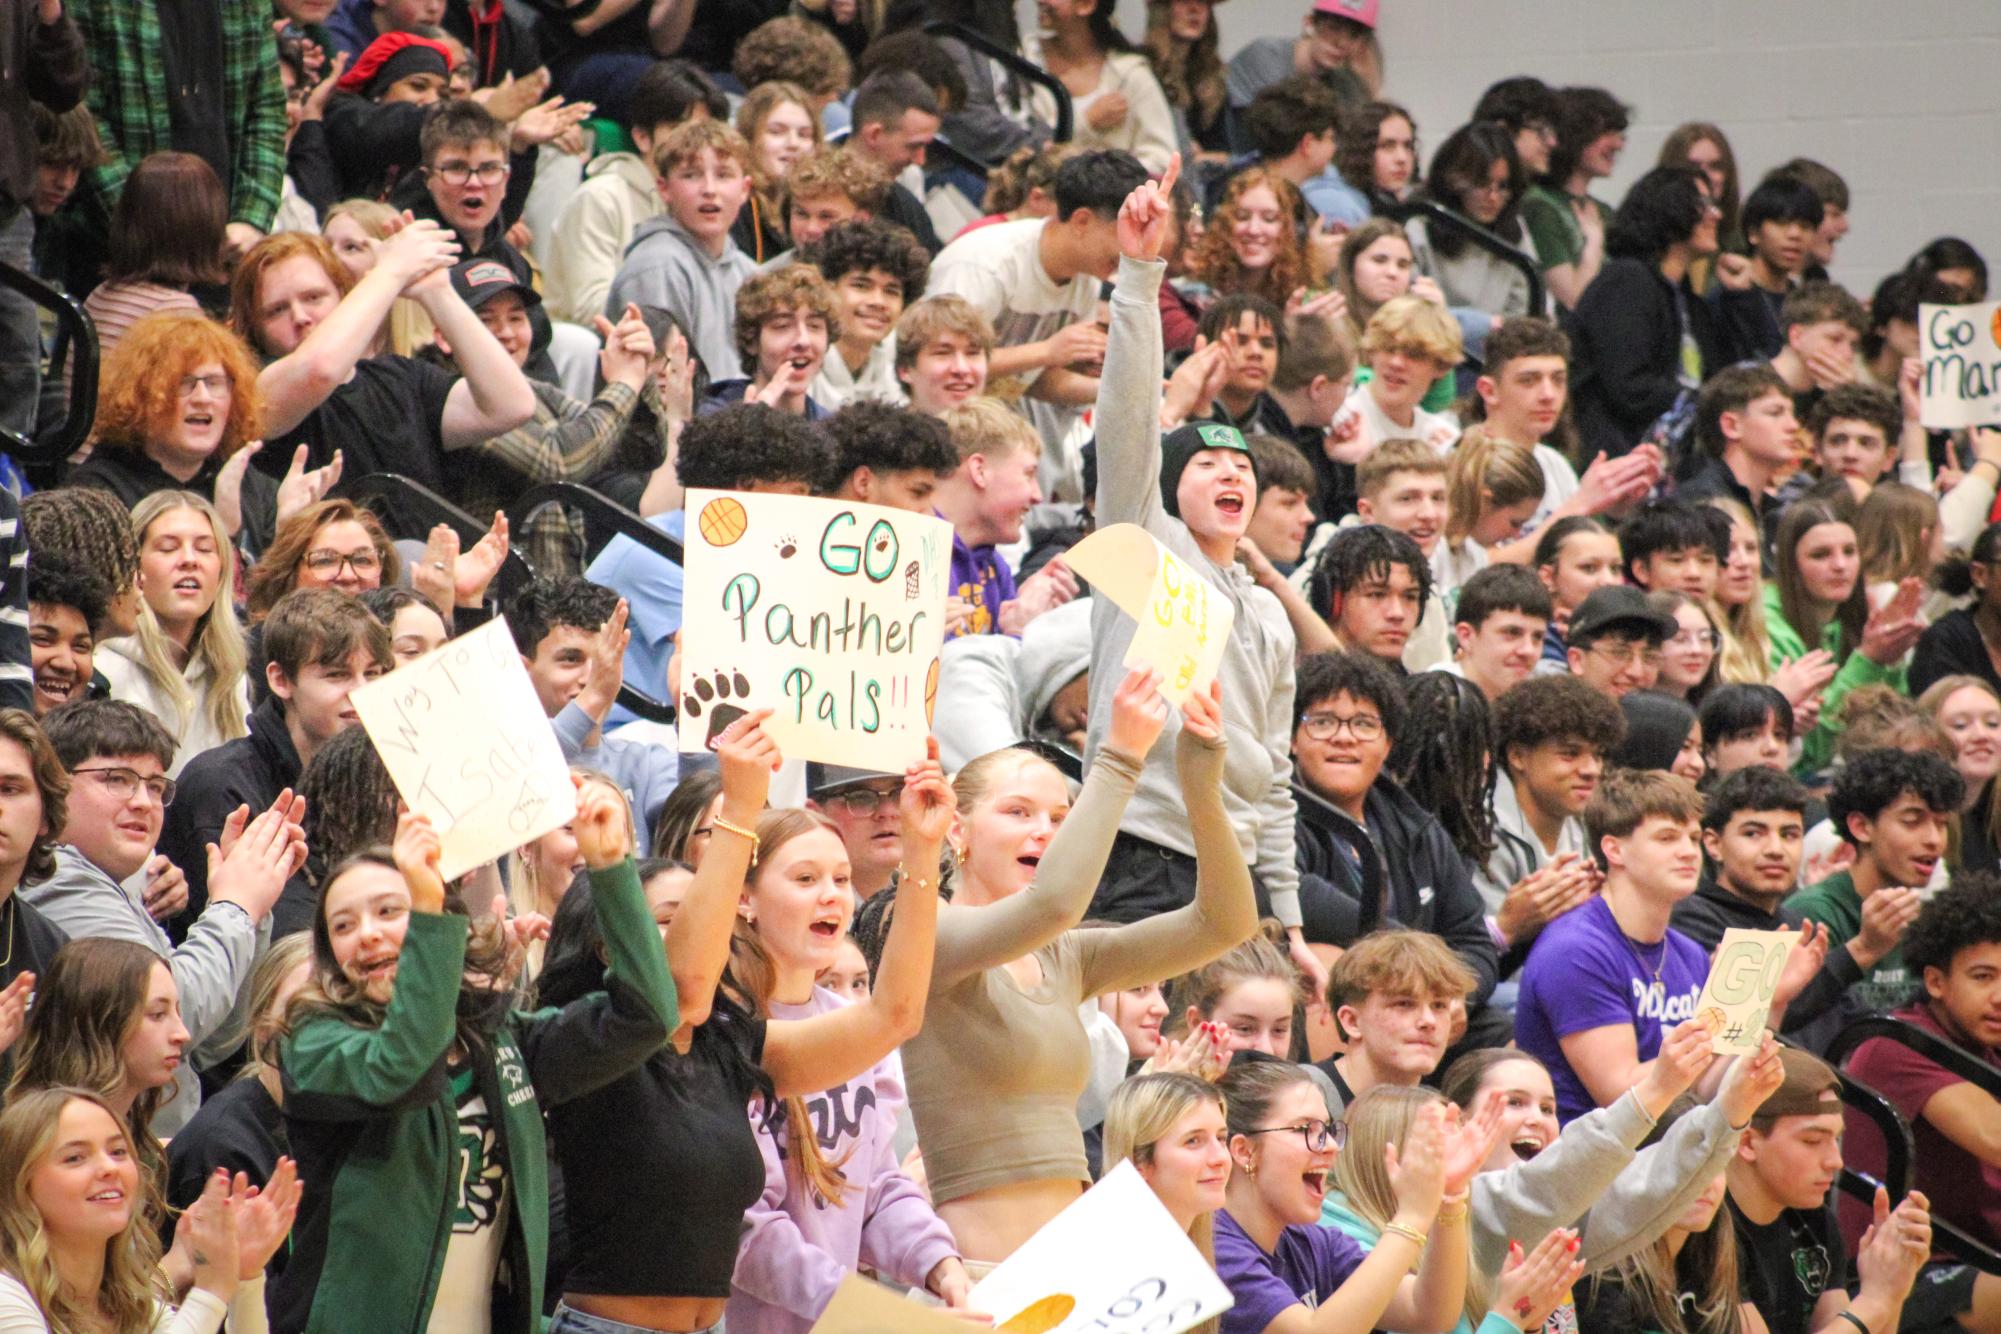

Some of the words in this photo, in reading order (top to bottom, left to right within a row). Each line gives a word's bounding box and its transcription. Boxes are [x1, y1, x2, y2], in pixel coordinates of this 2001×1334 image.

[1929, 309, 1975, 350] Go
[819, 511, 899, 583] GO
[722, 572, 927, 656] Panther
[380, 685, 432, 756] Way
[784, 666, 908, 734] Pals!!
[1710, 941, 1786, 1006] GO
